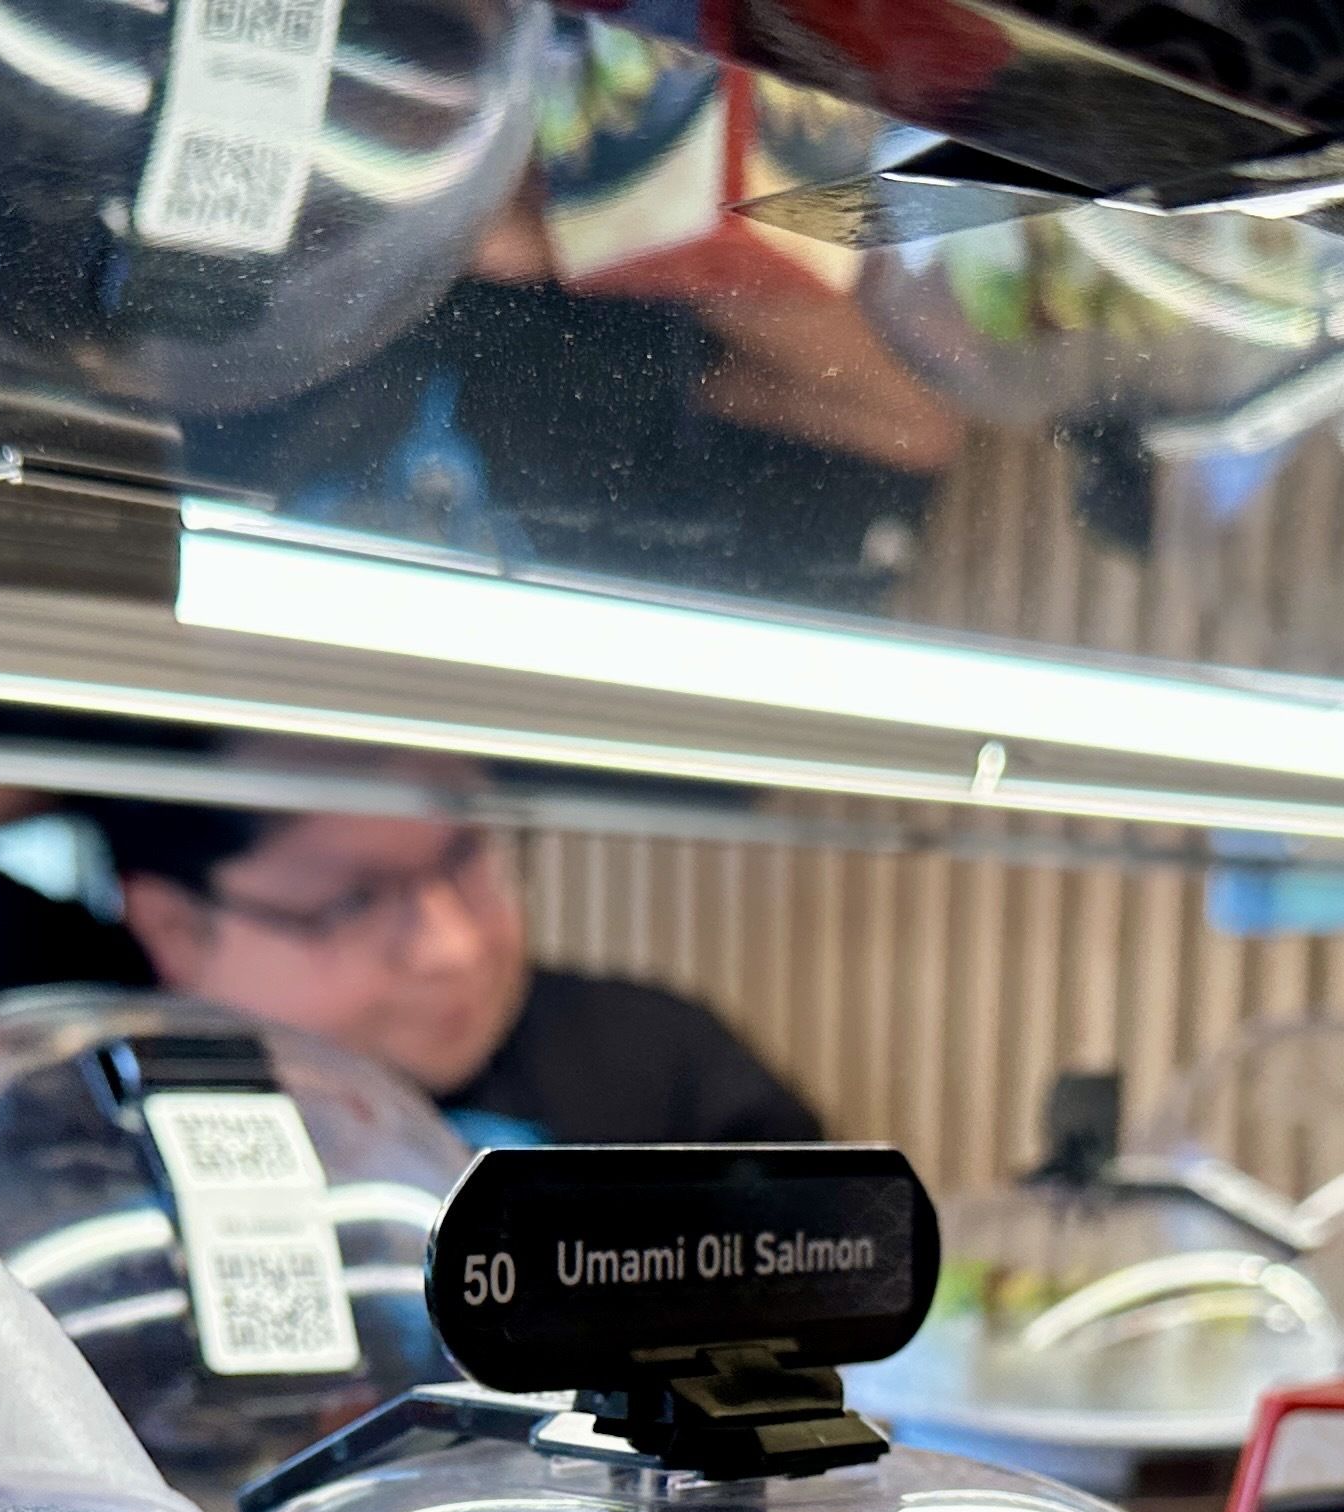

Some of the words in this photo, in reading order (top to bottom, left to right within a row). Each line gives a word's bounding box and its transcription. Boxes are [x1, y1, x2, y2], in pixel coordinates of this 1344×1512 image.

[464, 1252, 516, 1307] 50
[558, 1236, 685, 1286] Umami
[697, 1233, 745, 1279] Oil
[755, 1231, 874, 1277] Salmon
